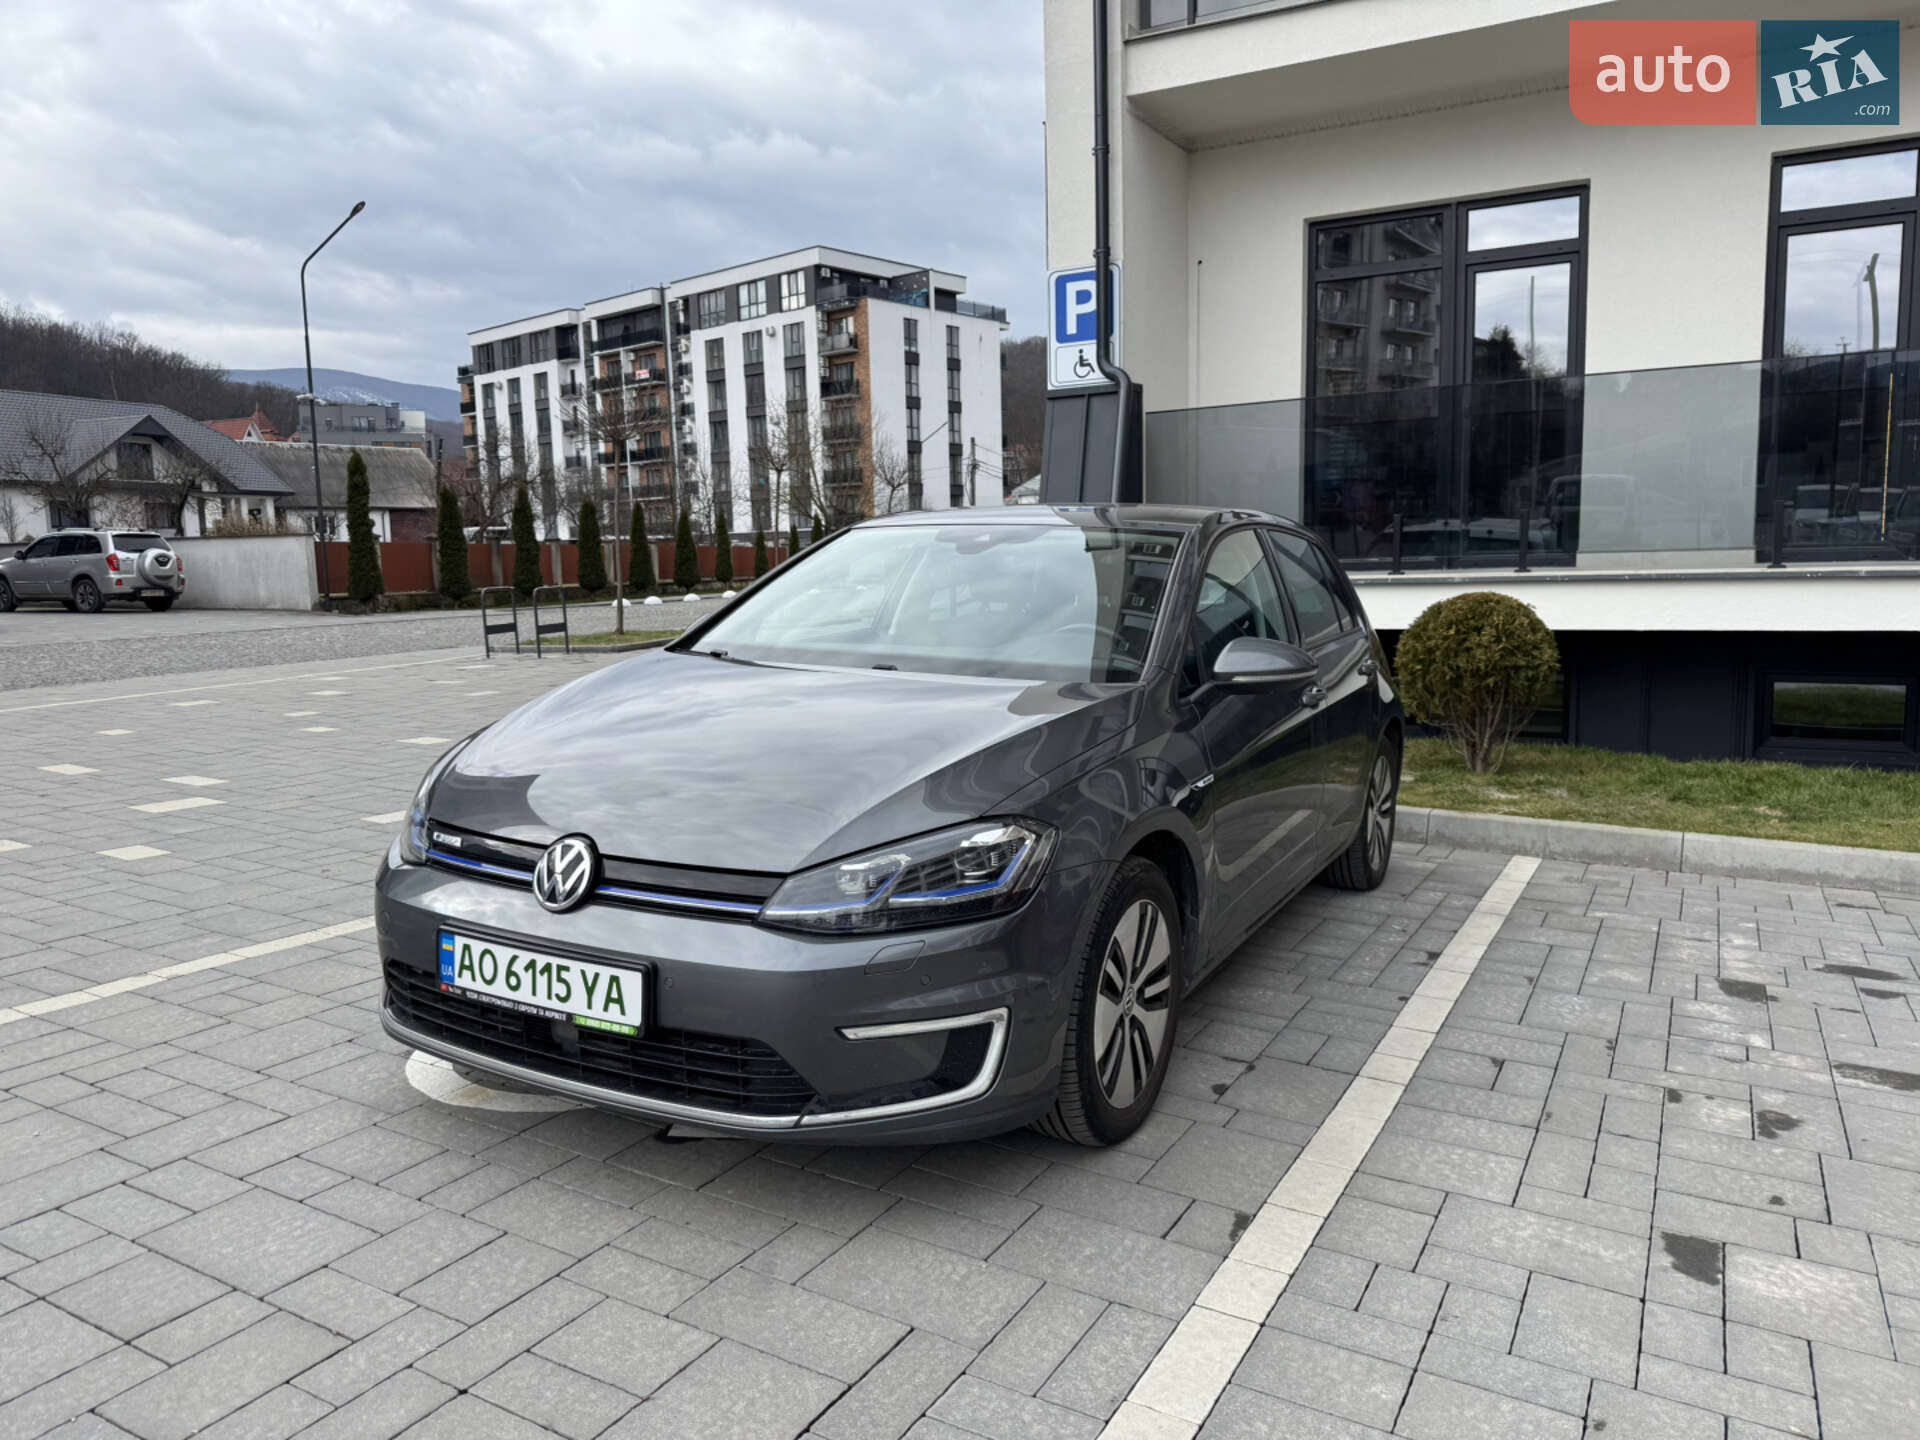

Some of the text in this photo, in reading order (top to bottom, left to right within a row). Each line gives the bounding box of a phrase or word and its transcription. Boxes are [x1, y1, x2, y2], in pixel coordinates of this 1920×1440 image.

[1066, 280, 1097, 336] P
[441, 963, 454, 977] UA
[457, 943, 499, 986] AO
[505, 954, 572, 1003] 6115
[580, 968, 626, 1017] YA
